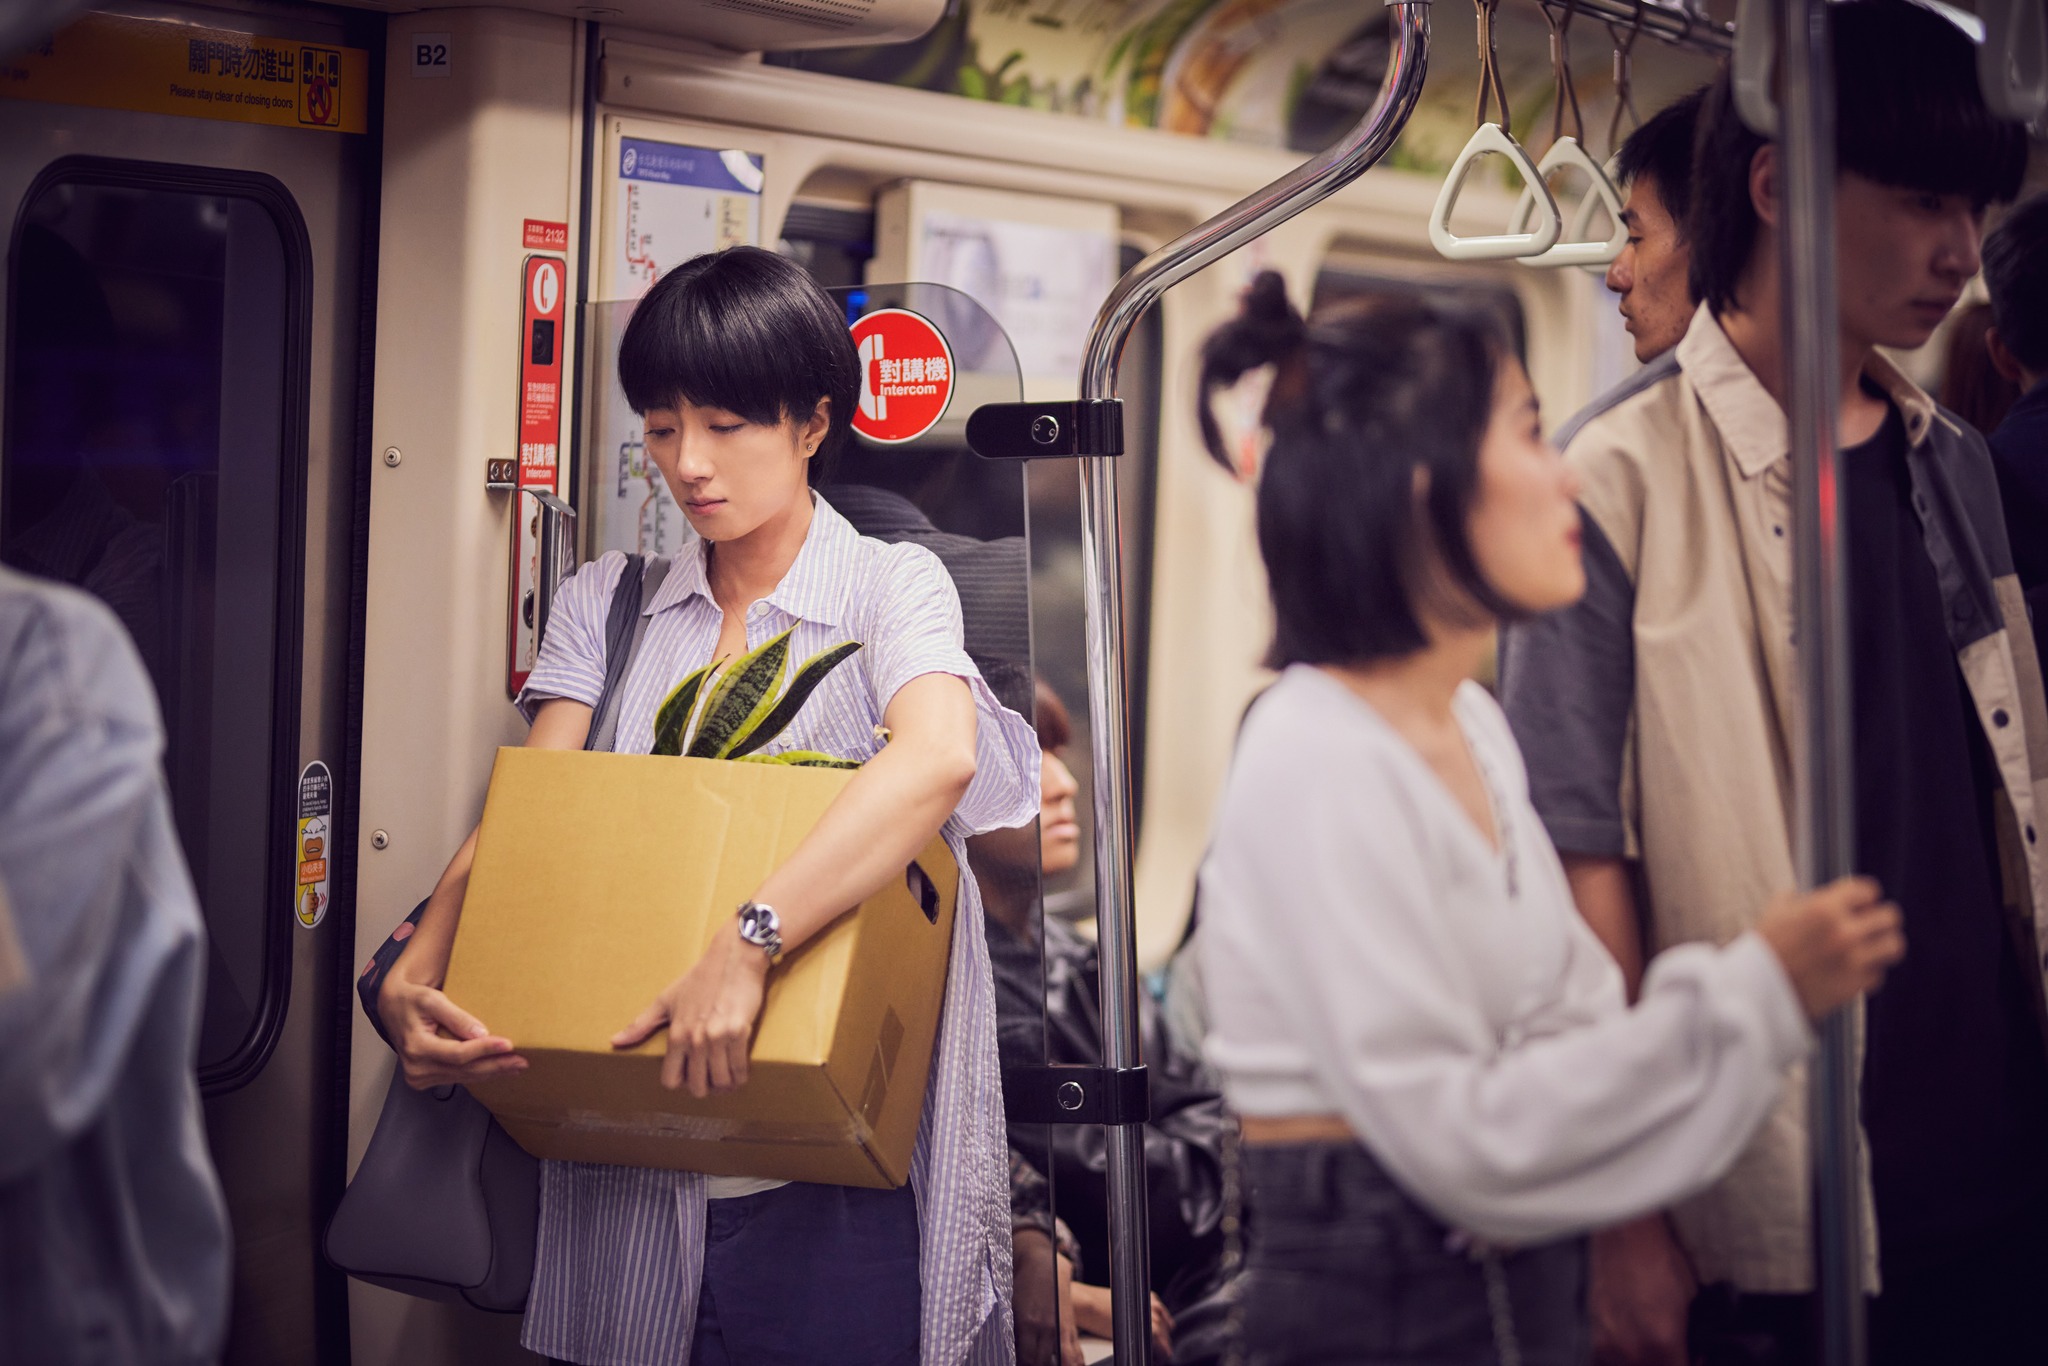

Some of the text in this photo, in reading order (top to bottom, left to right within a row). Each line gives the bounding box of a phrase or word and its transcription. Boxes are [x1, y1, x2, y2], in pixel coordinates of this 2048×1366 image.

[188, 38, 295, 84] 關門時勿進出
[416, 44, 447, 66] B2
[169, 83, 293, 109] Please stay clear of closing doors
[545, 227, 565, 244] 2132
[879, 356, 948, 384] 對講機
[879, 384, 937, 397] Intercom
[521, 442, 556, 467] 對講機
[525, 467, 552, 479] Intercom
